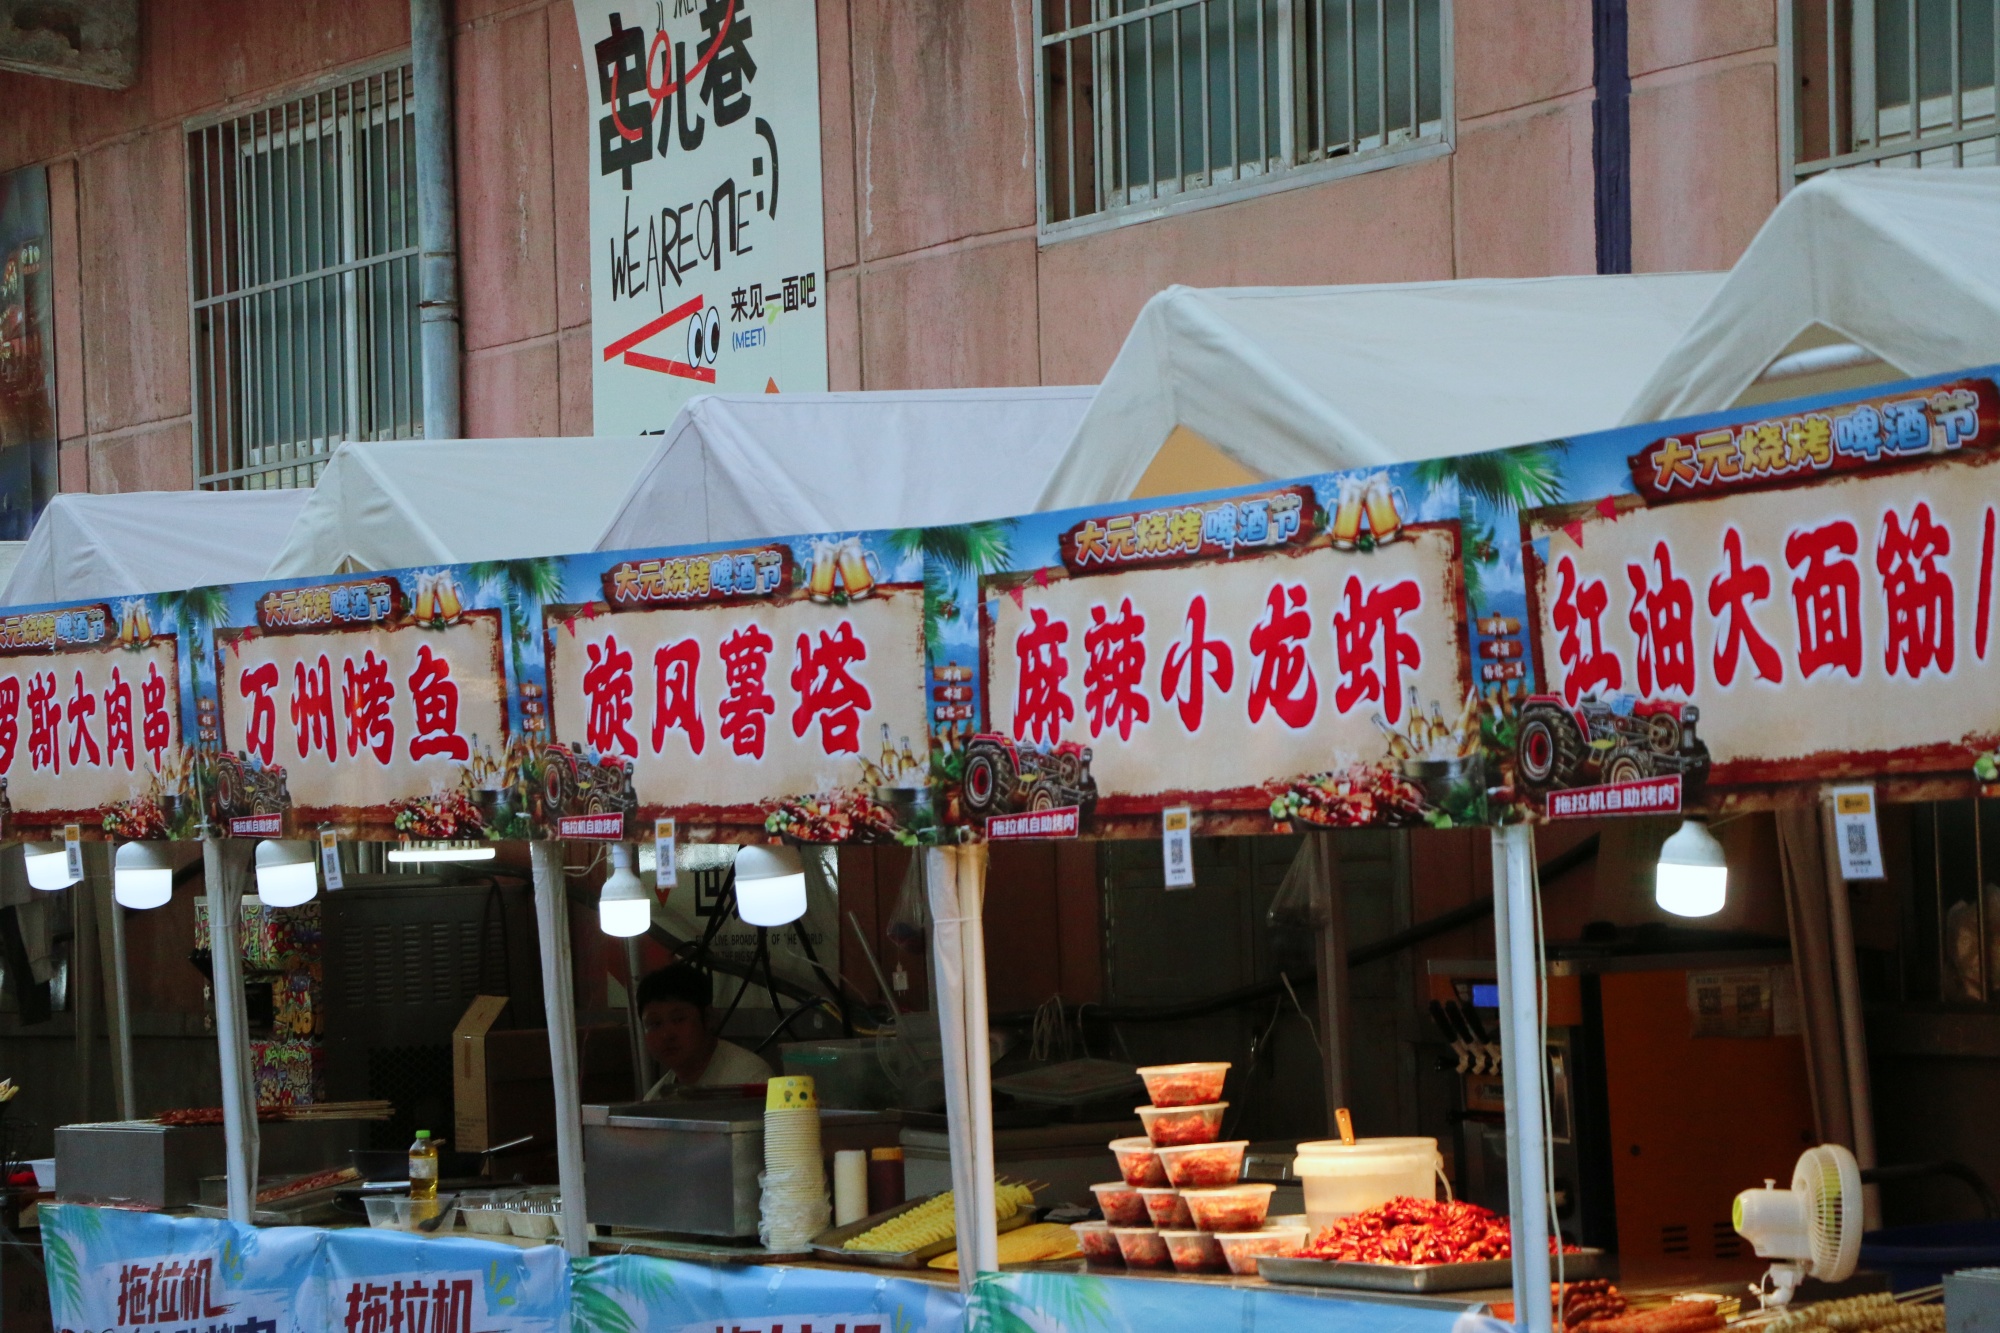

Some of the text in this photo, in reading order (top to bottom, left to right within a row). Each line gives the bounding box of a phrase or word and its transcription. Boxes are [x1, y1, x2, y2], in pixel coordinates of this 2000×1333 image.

[730, 272, 817, 323] 来见一面吧
[1013, 575, 1422, 746] 麻辣小龙虾
[240, 645, 469, 765] 万州烤鱼
[583, 620, 872, 759] 旋风薯塔
[991, 810, 1076, 836] 拖拉机自助烤肉
[1554, 782, 1676, 814] 拖拉机自助烤肉
[731, 934, 768, 945] BROADC
[117, 1257, 228, 1326] 拖拉机
[344, 1279, 474, 1333] 拖拉机
